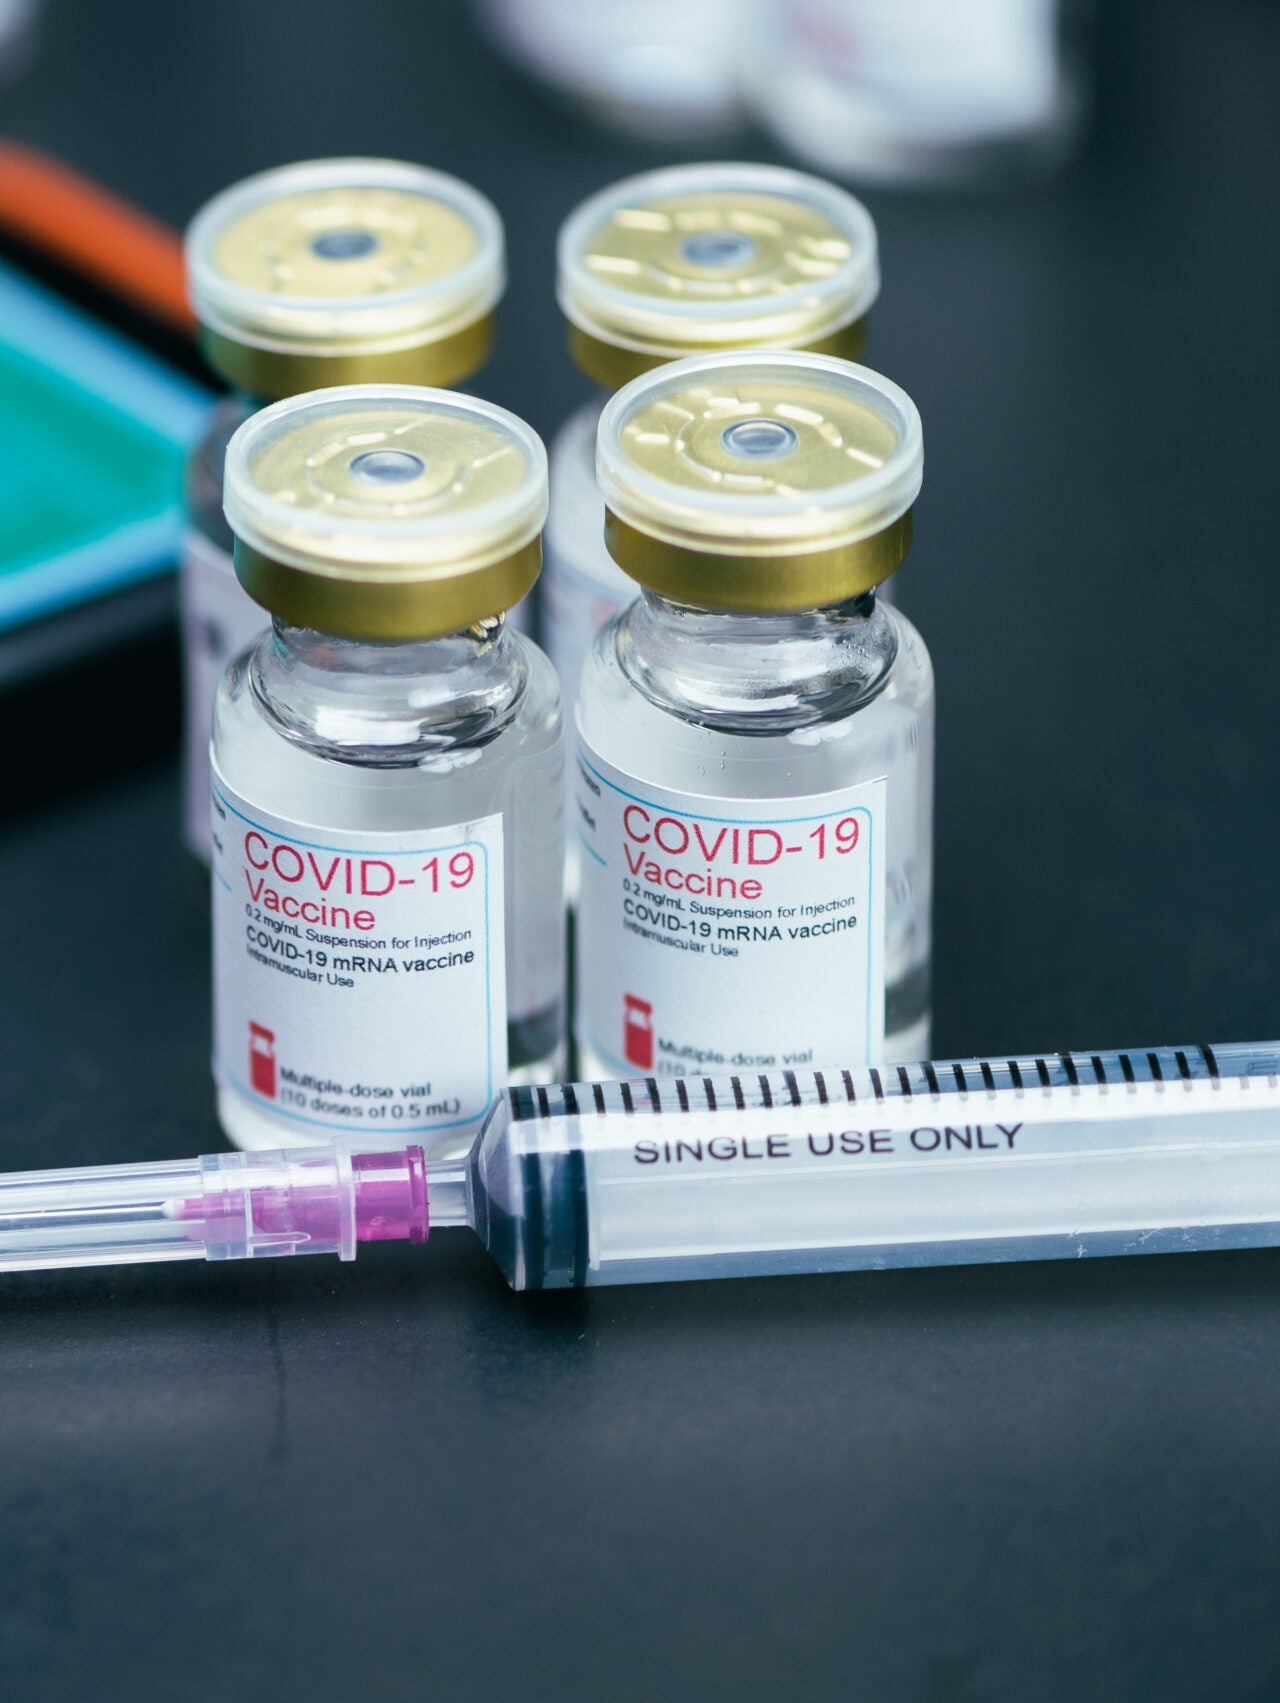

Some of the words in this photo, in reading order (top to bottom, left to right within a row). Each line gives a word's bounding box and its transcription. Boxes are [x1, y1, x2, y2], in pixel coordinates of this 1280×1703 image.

[621, 804, 859, 866] COVID-19
[244, 831, 475, 897] COVID-19
[622, 842, 763, 900] Vaccine
[244, 867, 376, 931] Vaccine
[643, 889, 686, 912] mg/mL
[689, 900, 773, 920] Suspension
[777, 905, 797, 919] for
[800, 896, 856, 918] Injection
[263, 915, 304, 939] mg/mL
[305, 928, 387, 950] Suspension
[391, 936, 412, 950] for
[414, 929, 472, 950] Injection
[623, 898, 712, 938] COVID-19
[717, 924, 783, 942] mRNA
[787, 915, 858, 940] vaccine
[246, 924, 328, 968] COVID-19
[333, 956, 399, 974] mRNA
[403, 949, 475, 973] vaccine
[710, 942, 740, 958] Use
[326, 972, 355, 989] Use
[782, 1047, 814, 1065] vial
[280, 1065, 394, 1099] Multiple-dose
[400, 1082, 432, 1098] vial
[310, 1098, 364, 1119] doses
[367, 1103, 387, 1119] of
[425, 1097, 461, 1117] mL)
[632, 1132, 792, 1165] SINGLE
[807, 1128, 896, 1156] USE
[909, 1122, 1025, 1152] ONLY
